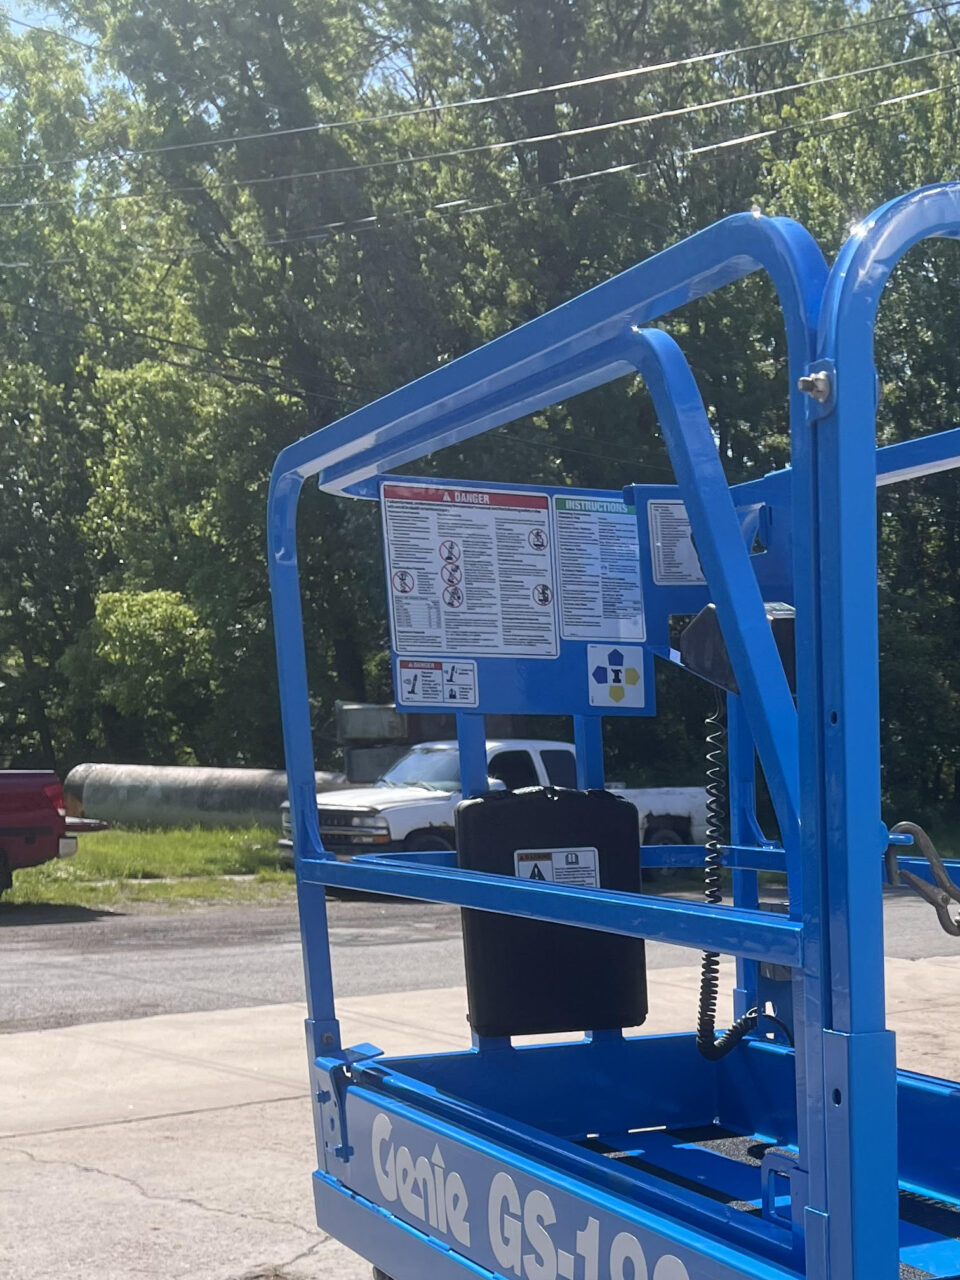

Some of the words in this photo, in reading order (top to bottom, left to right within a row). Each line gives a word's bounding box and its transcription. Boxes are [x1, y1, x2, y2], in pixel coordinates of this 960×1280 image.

[454, 492, 490, 504] DANGER
[566, 500, 628, 513] INSTRUCTIONS
[372, 1112, 471, 1248] Genie
